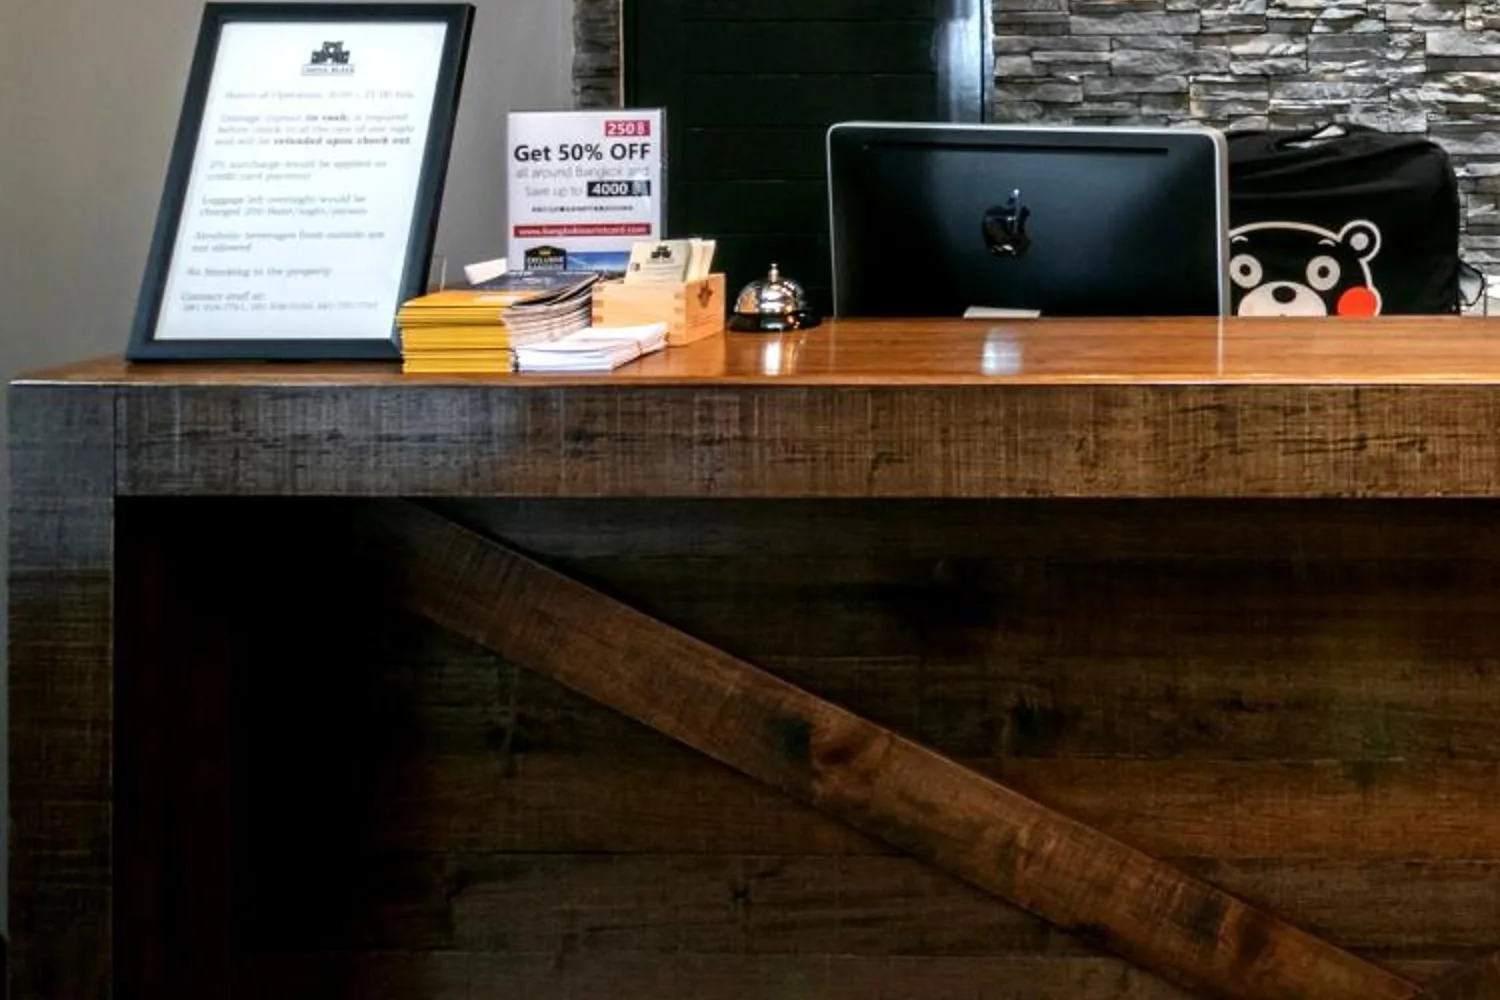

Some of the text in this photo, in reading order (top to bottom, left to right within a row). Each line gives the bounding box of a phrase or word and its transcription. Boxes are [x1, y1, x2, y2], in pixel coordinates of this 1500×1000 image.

[607, 123, 634, 135] 250
[514, 142, 651, 161] Get 50% OFF
[591, 183, 628, 195] 4000
